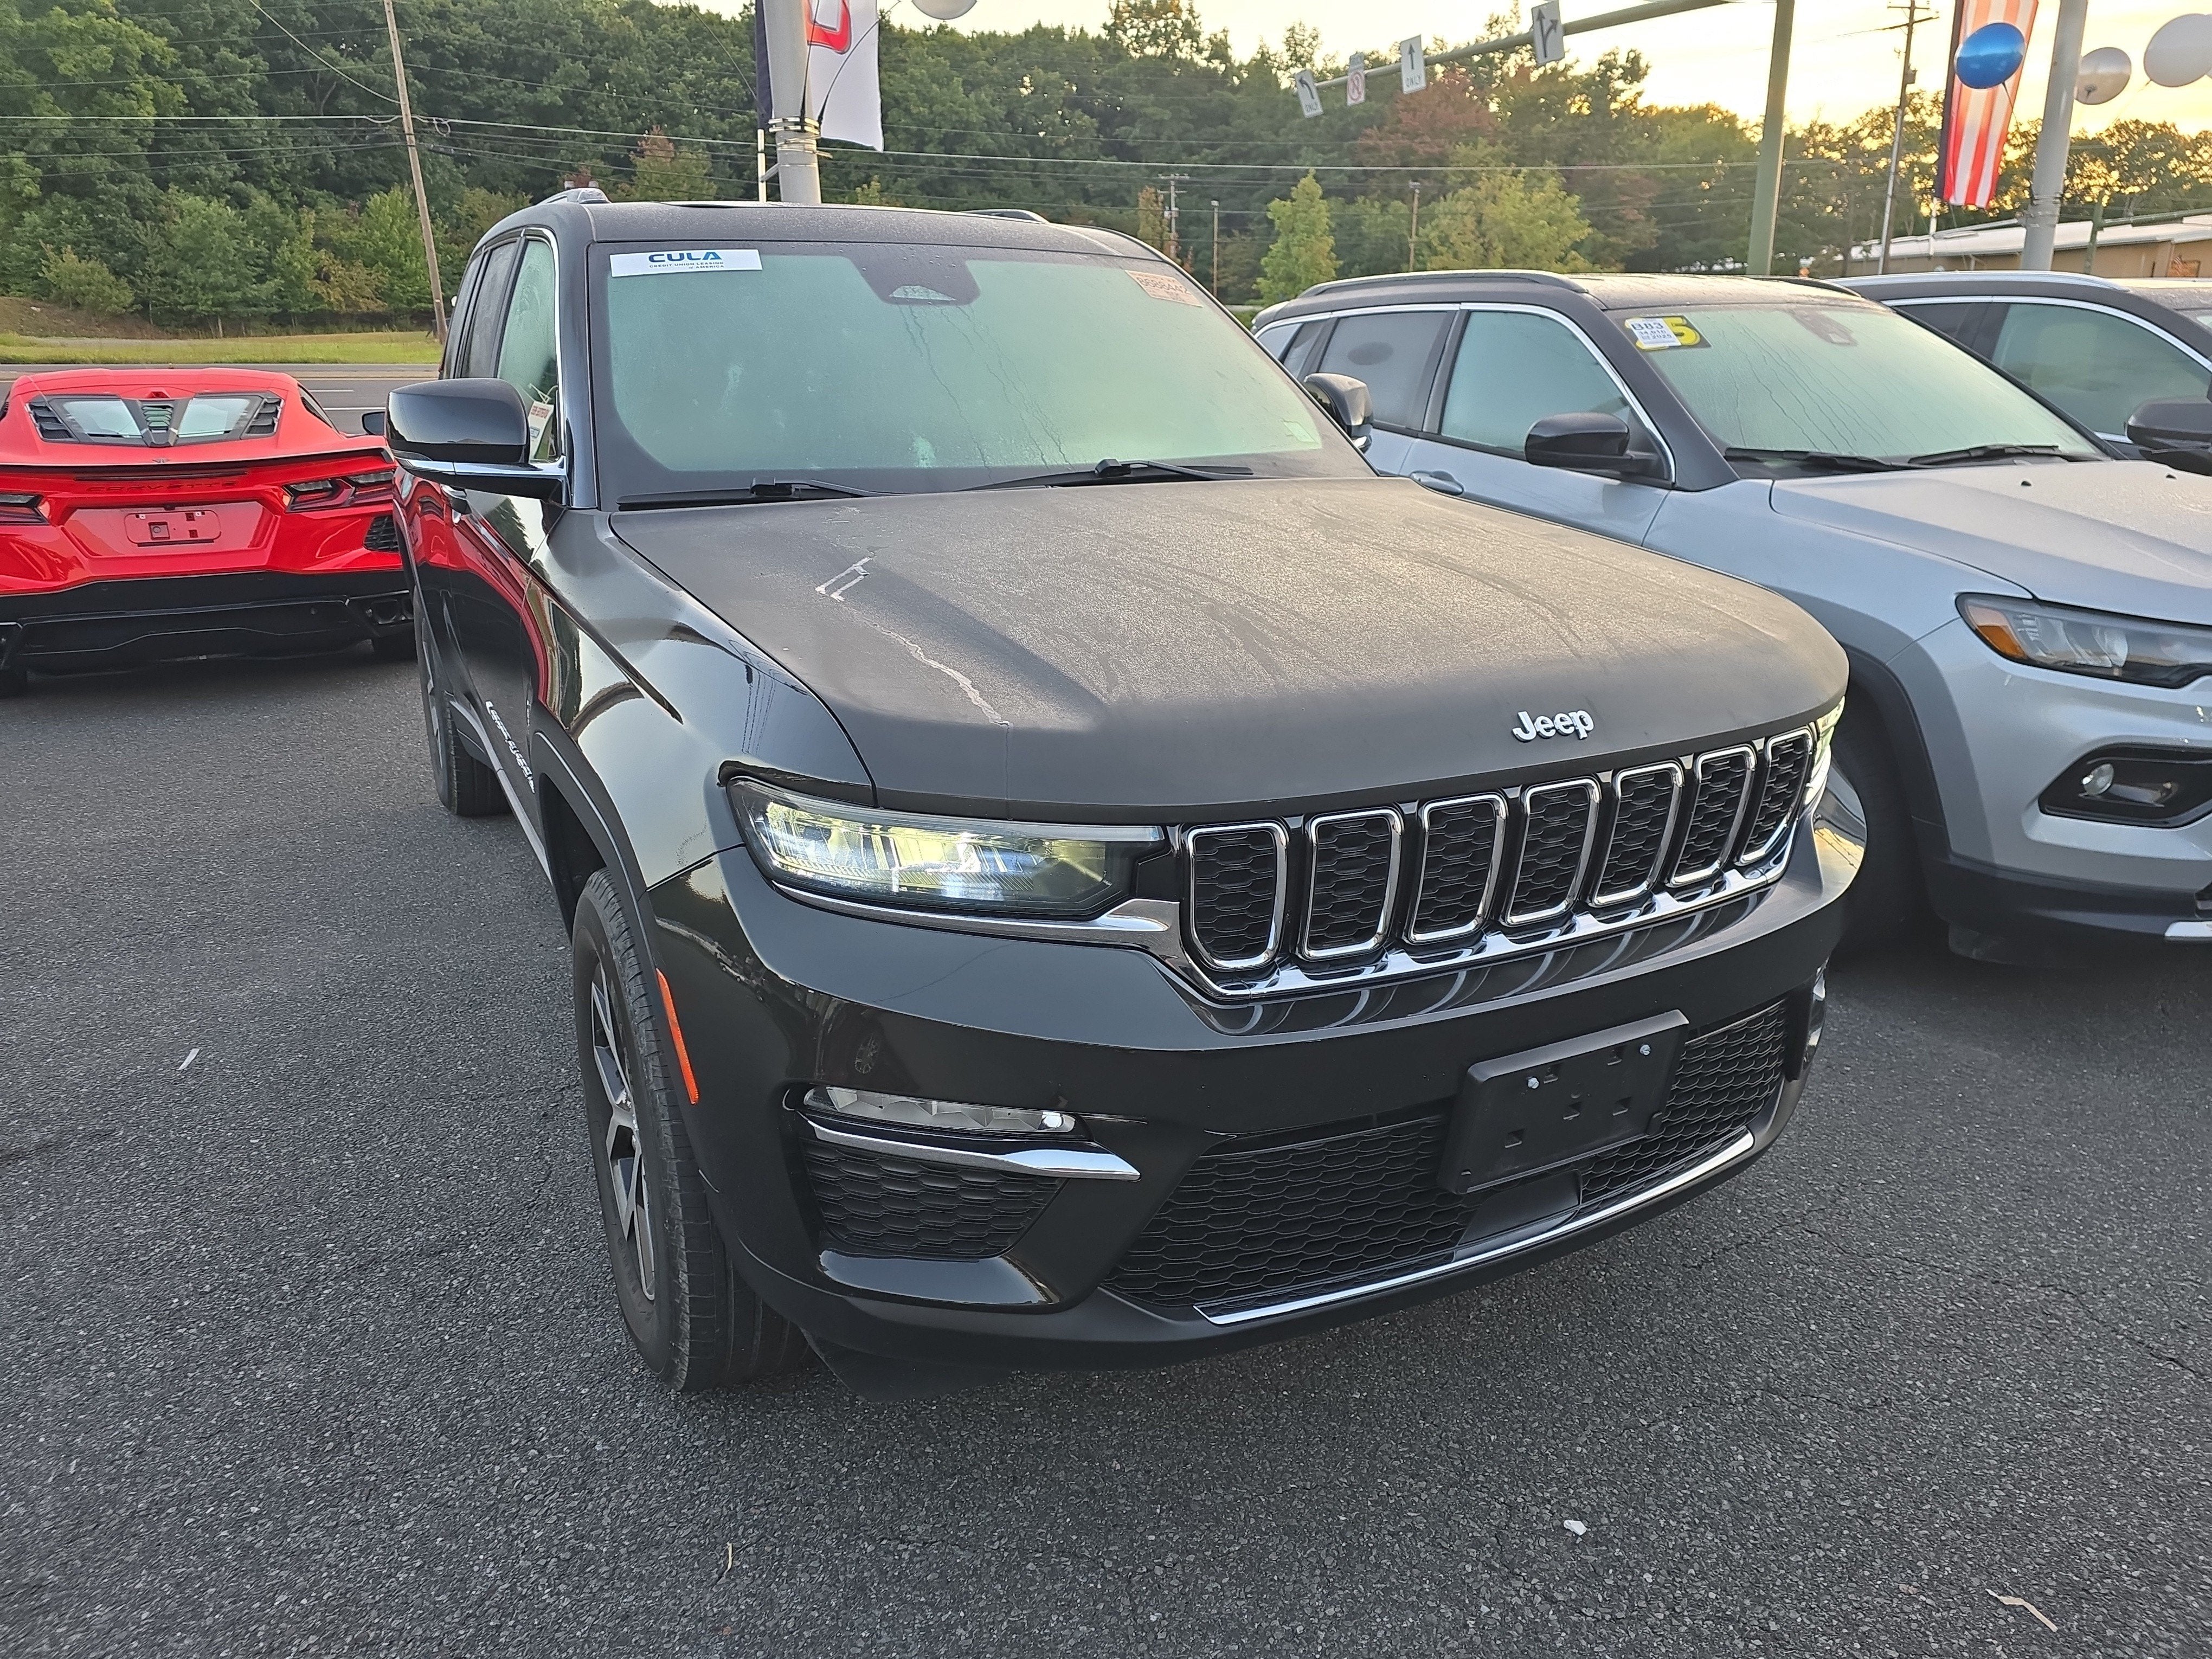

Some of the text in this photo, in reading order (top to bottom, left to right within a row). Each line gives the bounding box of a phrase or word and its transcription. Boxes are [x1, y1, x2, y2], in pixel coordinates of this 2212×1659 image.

[1405, 74, 1423, 87] ONLY
[1304, 101, 1320, 112] ONLY
[648, 252, 722, 262] CULA
[1137, 277, 1192, 295] 8688442
[1512, 710, 1594, 743] Jeep
